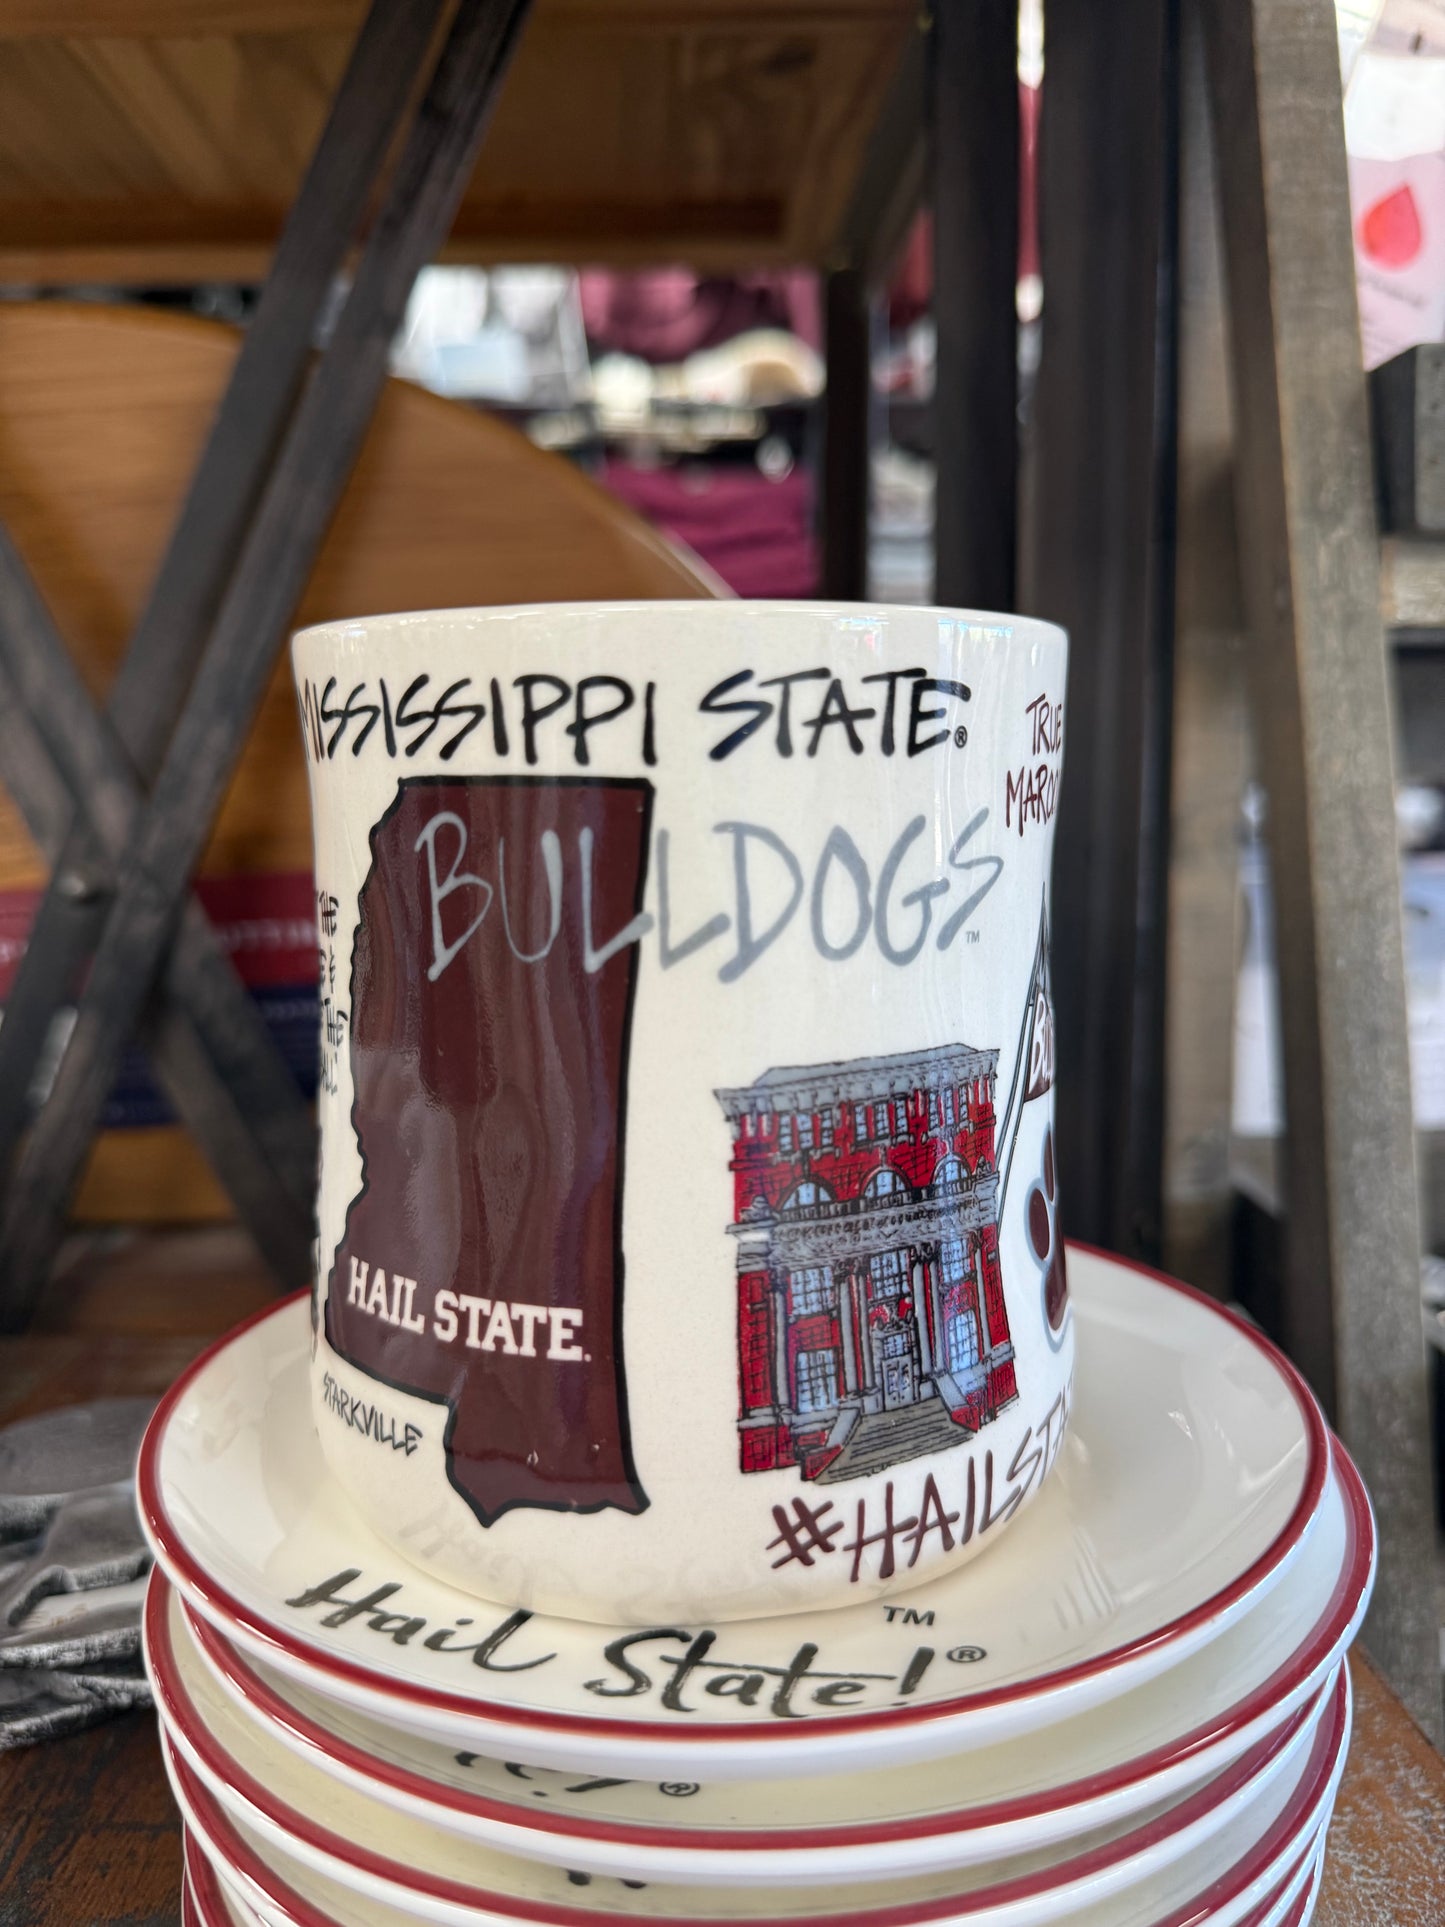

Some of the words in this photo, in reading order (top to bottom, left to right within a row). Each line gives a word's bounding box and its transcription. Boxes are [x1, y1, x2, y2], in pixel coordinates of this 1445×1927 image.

[298, 673, 657, 765] MISSISSIPPI
[1025, 693, 1062, 755] TRUE
[414, 808, 1004, 984] BULLDOGS
[348, 1256, 425, 1335] HAIL
[323, 1371, 423, 1456] STARKVILLE
[285, 1568, 557, 1672] Hail
